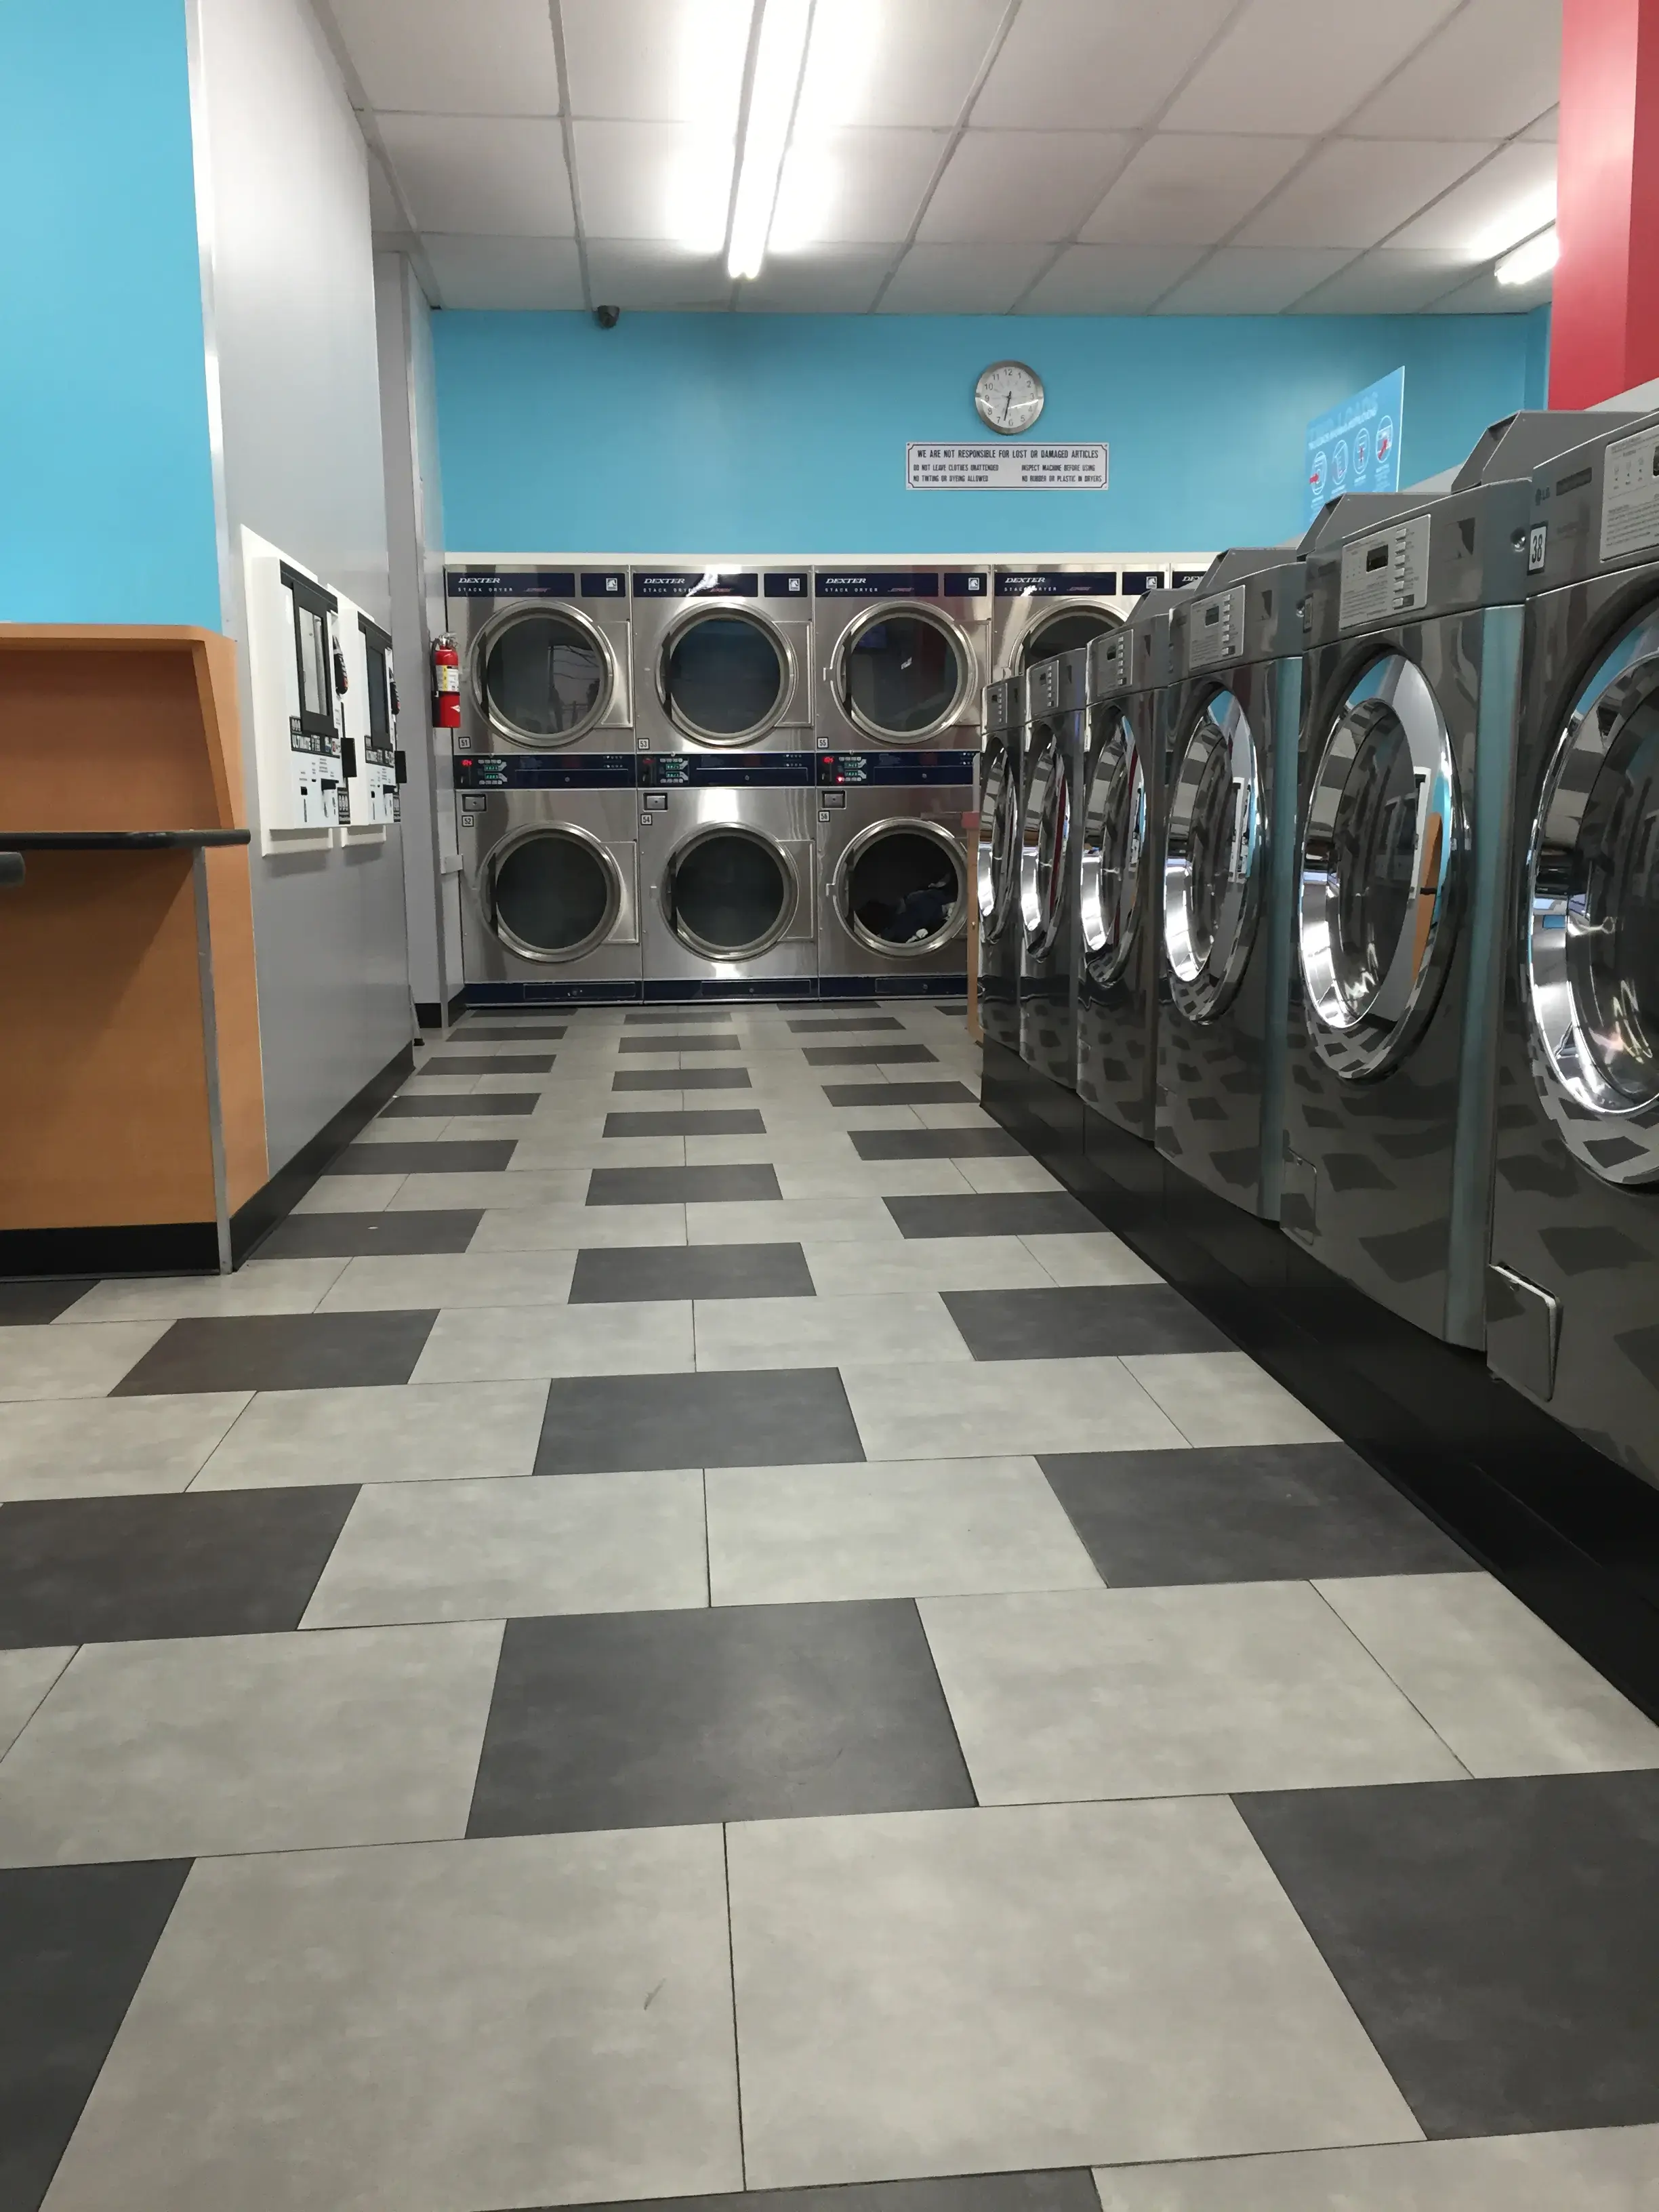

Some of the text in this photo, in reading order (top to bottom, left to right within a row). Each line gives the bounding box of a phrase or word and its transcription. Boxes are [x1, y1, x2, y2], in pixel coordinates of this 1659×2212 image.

[918, 450, 1099, 458] WE ARE NOT RESPONSIBLE FOR LOST OR DAMAGED ARTICLES
[1532, 533, 1542, 563] 38
